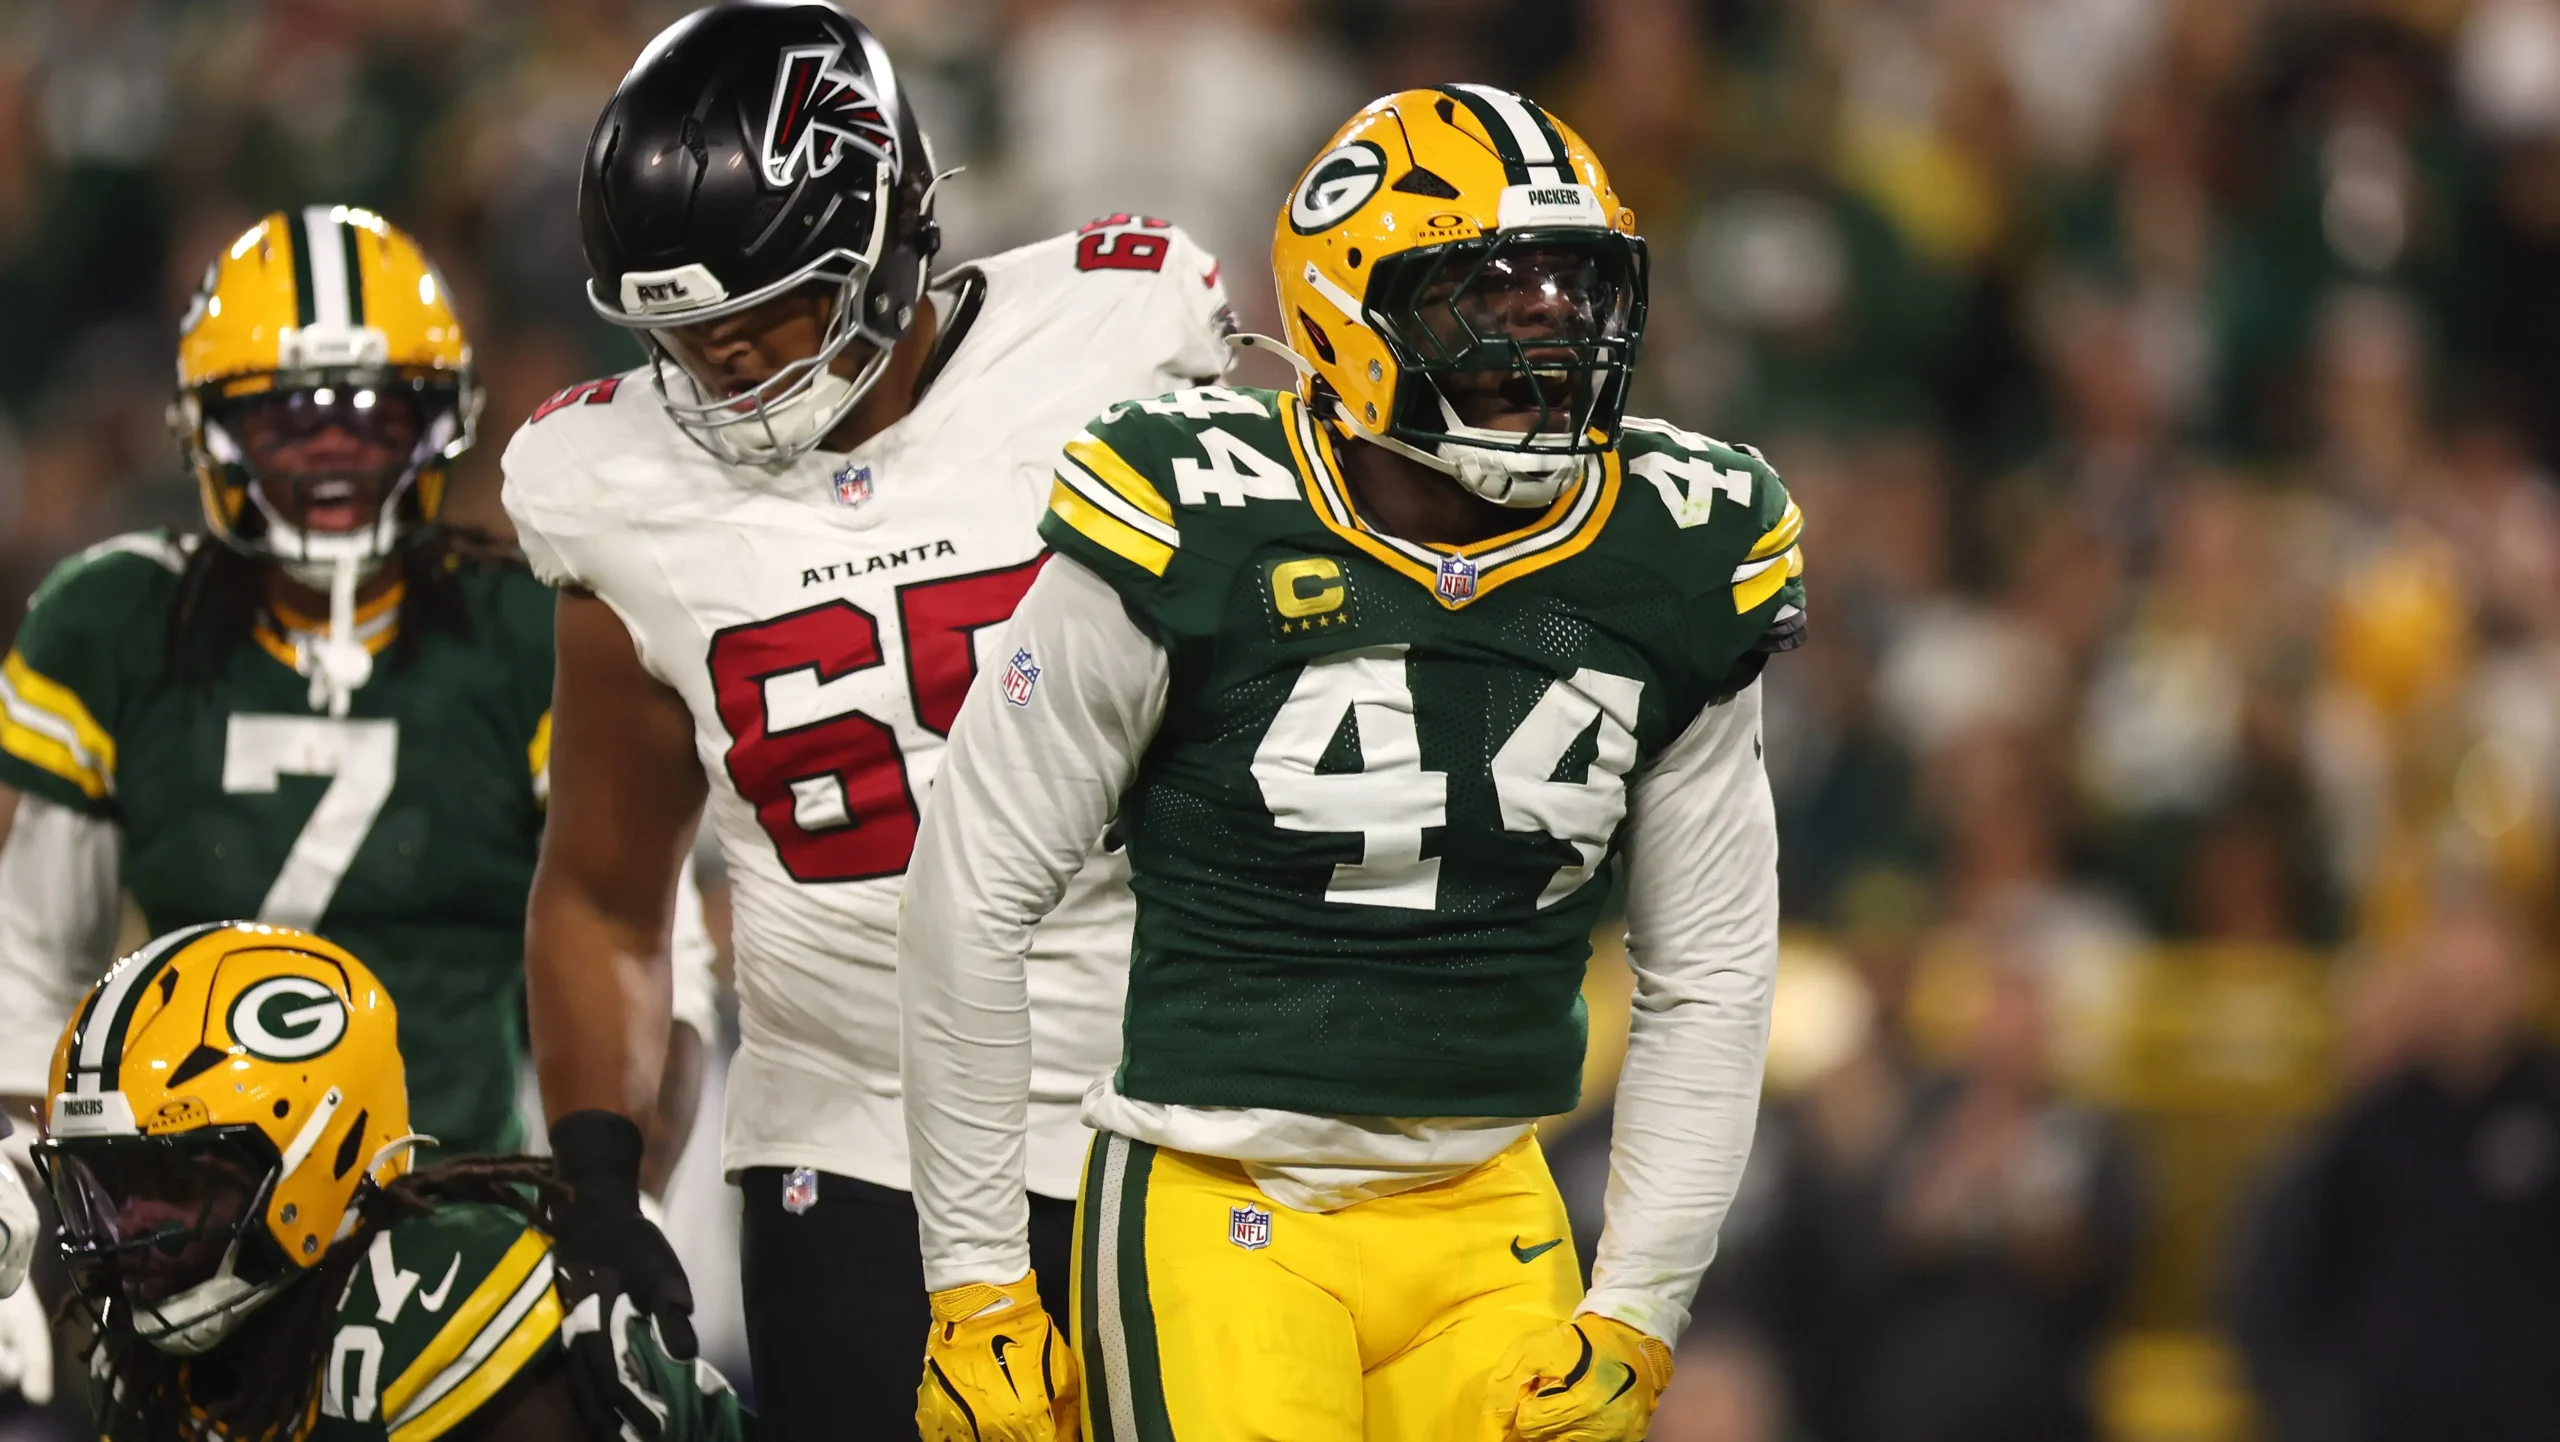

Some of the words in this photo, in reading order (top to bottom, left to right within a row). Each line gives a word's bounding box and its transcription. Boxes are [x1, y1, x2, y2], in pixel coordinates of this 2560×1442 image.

[1289, 140, 1387, 235] G
[1528, 189, 1580, 206] PACKERS
[1418, 228, 1472, 238] OAKLEY
[636, 279, 689, 302] ATL
[801, 539, 957, 588] ATLANTA
[1271, 557, 1344, 618] C
[1442, 575, 1470, 597] NFL
[1003, 665, 1029, 701] NFL
[222, 712, 399, 933] 7
[225, 974, 348, 1063] G
[63, 1099, 103, 1117] PACKERS
[1236, 1223, 1264, 1242] NFL
